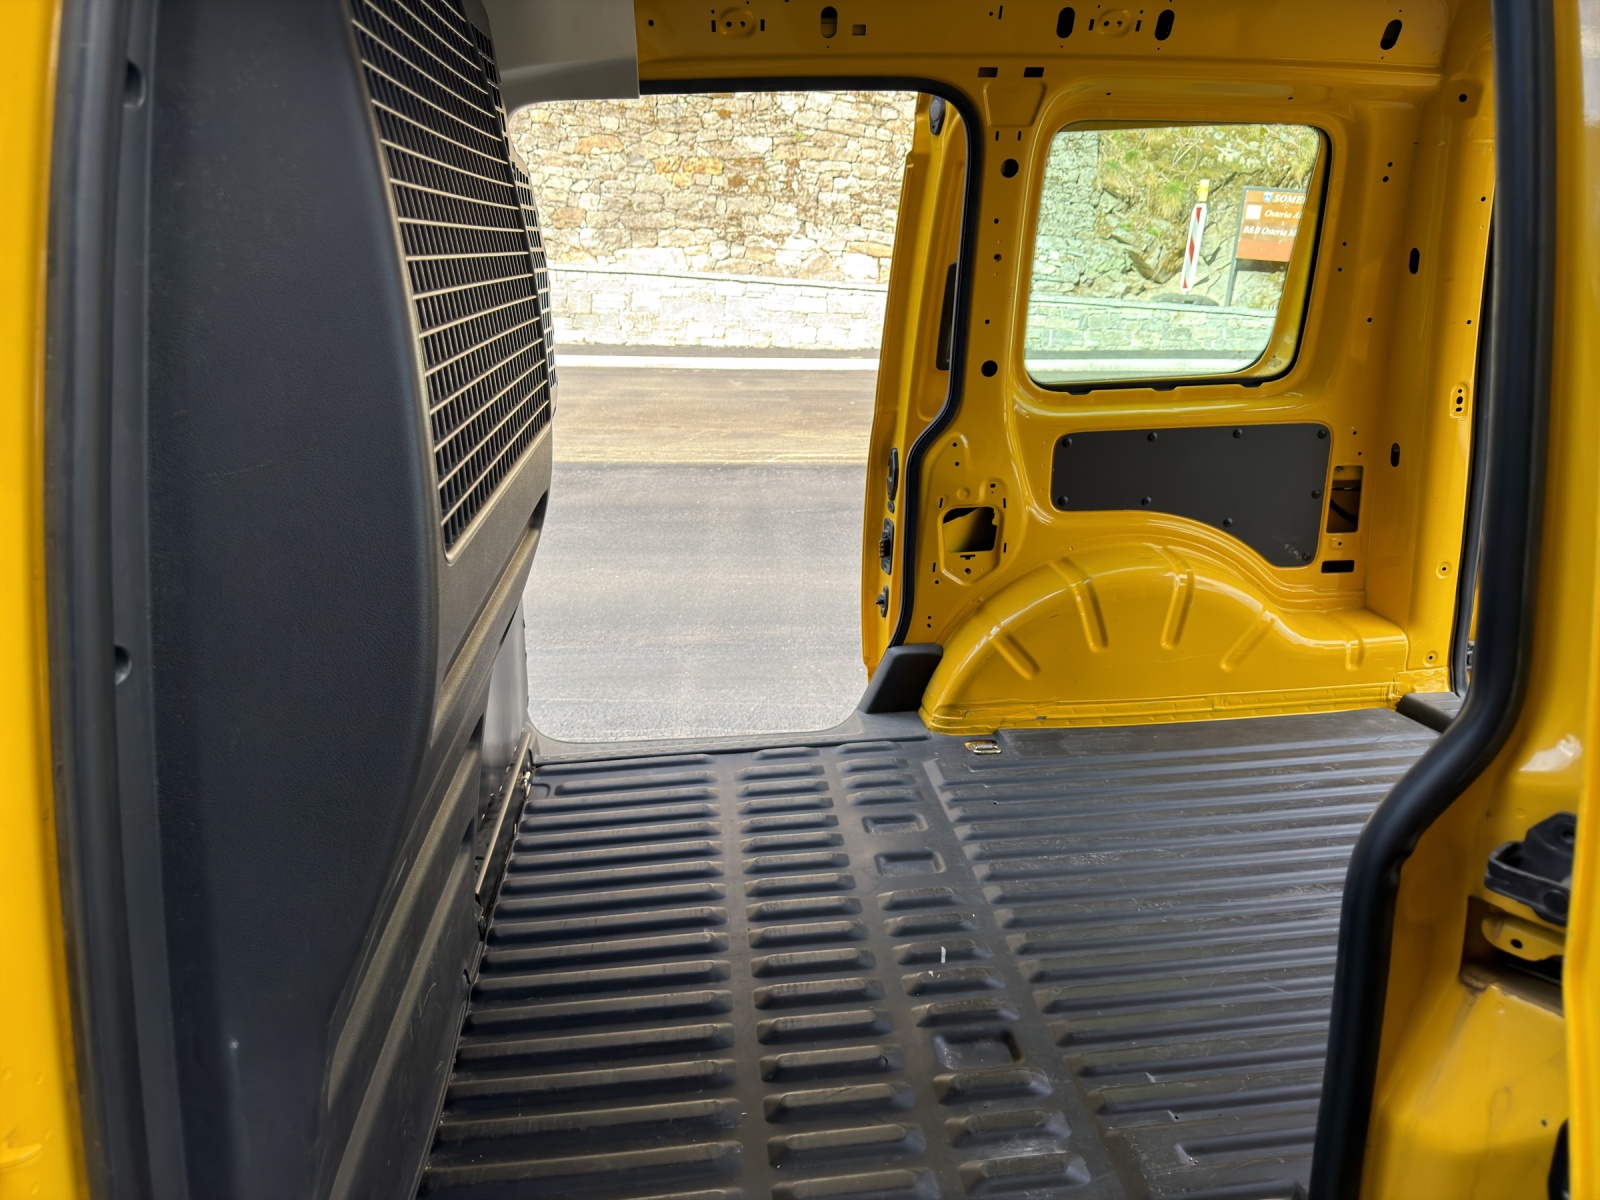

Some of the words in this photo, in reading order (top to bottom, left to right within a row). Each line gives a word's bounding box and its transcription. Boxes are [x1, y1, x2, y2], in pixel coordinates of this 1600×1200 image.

[1264, 209, 1292, 218] Osteria
[1242, 225, 1261, 234] B&B
[1261, 226, 1288, 236] Osteria
